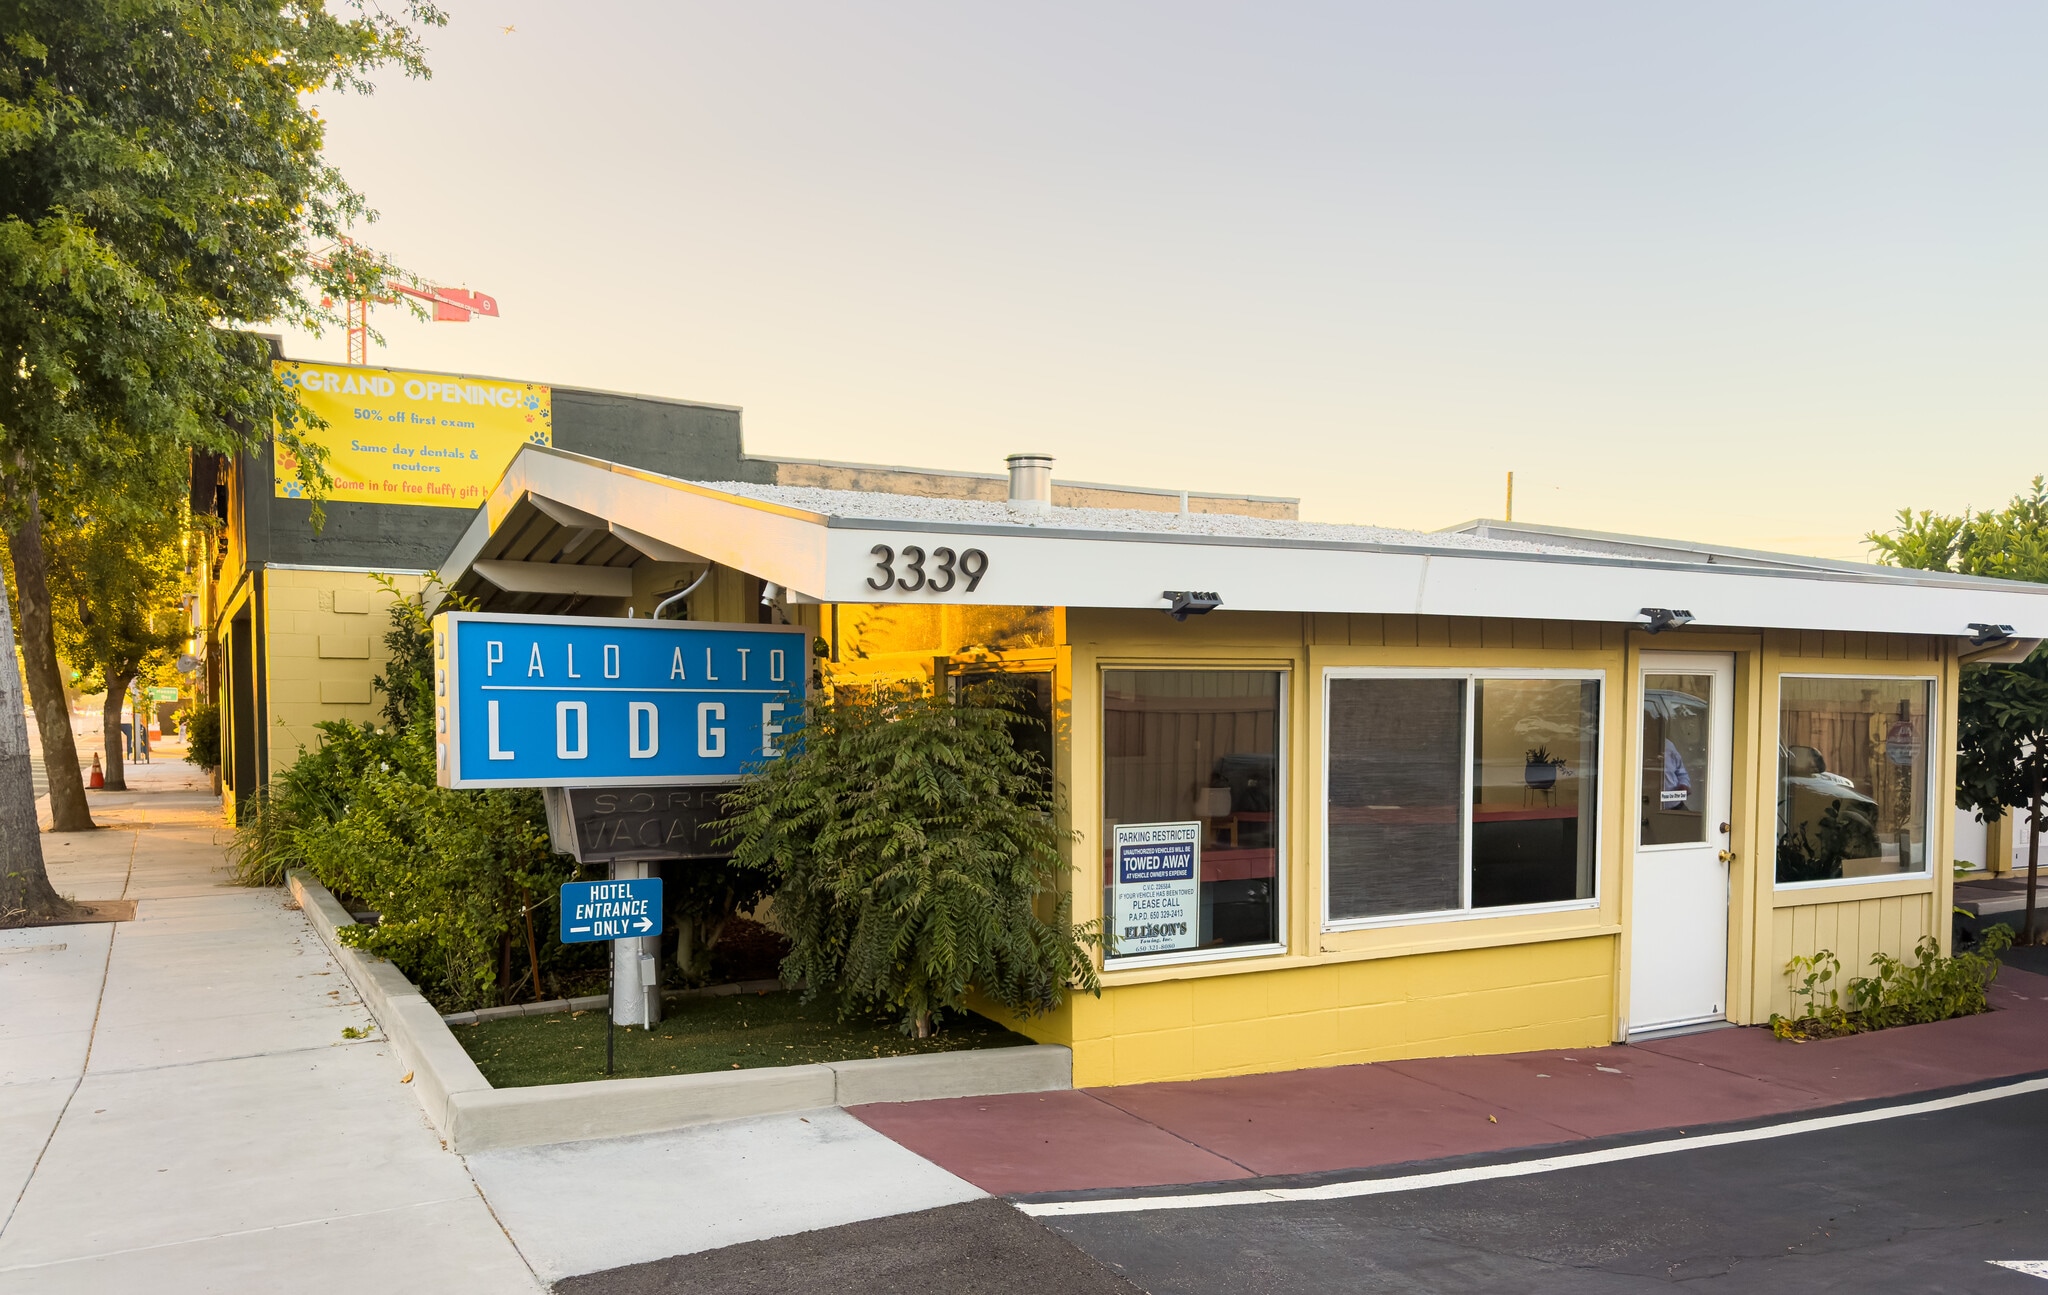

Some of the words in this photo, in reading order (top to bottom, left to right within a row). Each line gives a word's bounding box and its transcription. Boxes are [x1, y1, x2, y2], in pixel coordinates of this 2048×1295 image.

[300, 370, 396, 397] GRAND
[403, 379, 523, 409] OPENING!
[353, 408, 383, 421] 50%
[388, 411, 406, 423] off
[410, 412, 436, 425] first
[441, 420, 476, 429] exam
[351, 440, 388, 454] Same
[392, 443, 415, 459] day
[419, 446, 465, 459] dentals
[469, 449, 479, 460] &
[392, 461, 441, 473] neuters
[334, 477, 365, 491] Come
[369, 479, 379, 491] in
[383, 480, 398, 493] for
[402, 481, 423, 494] free
[426, 482, 456, 499] fluffy
[460, 483, 479, 500] gift
[866, 543, 989, 593] 3339
[486, 640, 620, 679] PALO
[670, 646, 785, 682] ALTO
[488, 700, 786, 760] LODGE
[593, 791, 719, 814] SORR
[1119, 831, 1151, 843] PARKING
[1152, 829, 1196, 841] RESTRICTED
[1155, 846, 1175, 854] VEHICLES
[1124, 856, 1160, 871] TOWED
[1162, 854, 1190, 869] AWAY
[1150, 870, 1168, 878] OWNER'S
[590, 884, 634, 901] HOTEL
[1179, 888, 1194, 896] TOWED
[575, 899, 648, 920] ENTRANCE
[1133, 899, 1160, 909] PLEASE
[1162, 897, 1180, 908] CALL
[1150, 911, 1159, 920] 650
[1160, 909, 1184, 919] 329-2413
[594, 919, 630, 936] ONLY
